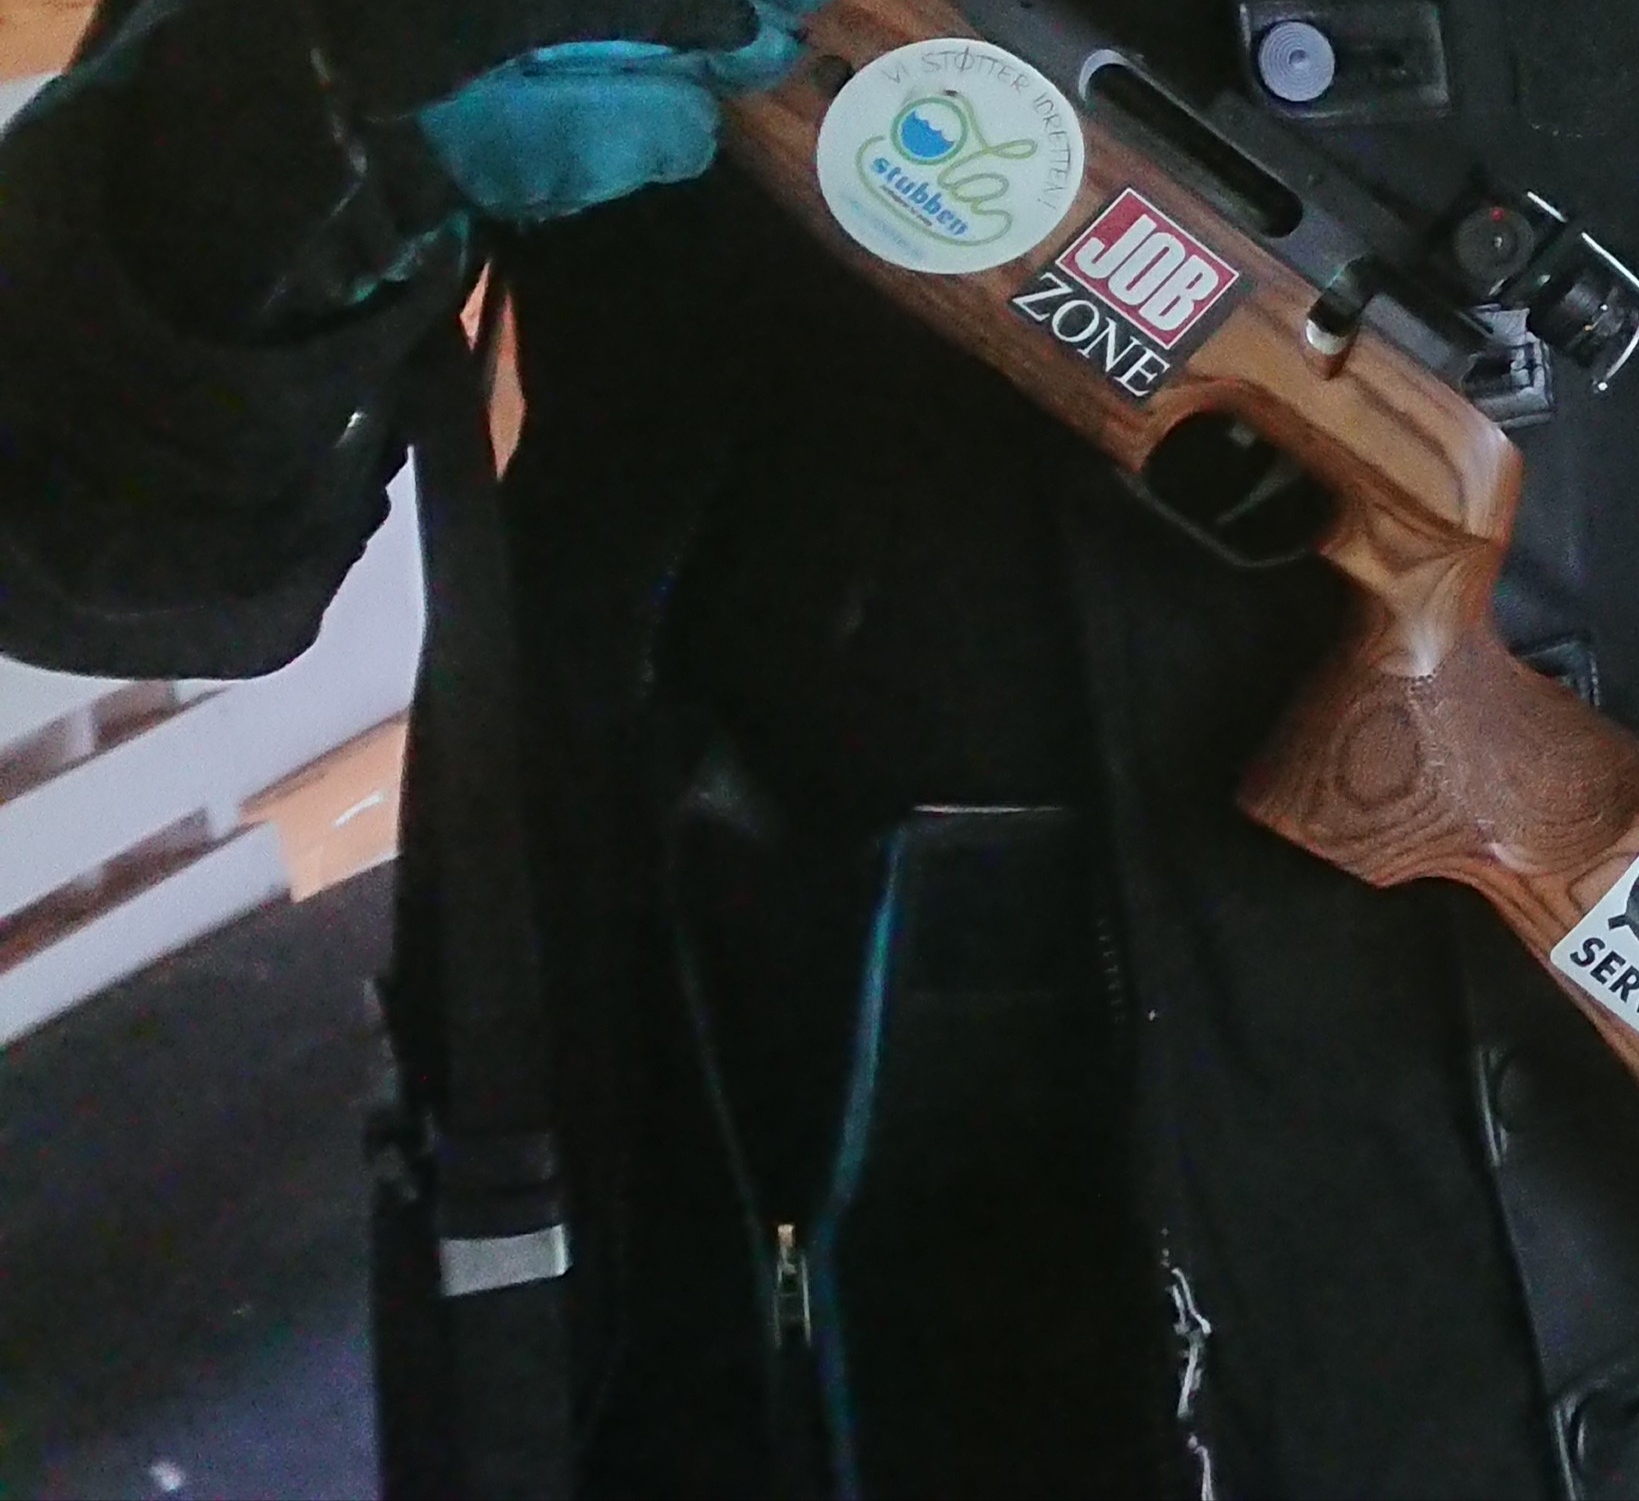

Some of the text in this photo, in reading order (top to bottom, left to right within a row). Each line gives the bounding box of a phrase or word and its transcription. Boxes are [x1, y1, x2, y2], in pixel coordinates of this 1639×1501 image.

[921, 46, 1031, 93] STØTTER
[870, 155, 970, 238] stubben
[1074, 212, 1221, 332] JOB
[1011, 271, 1172, 399] ZONE
